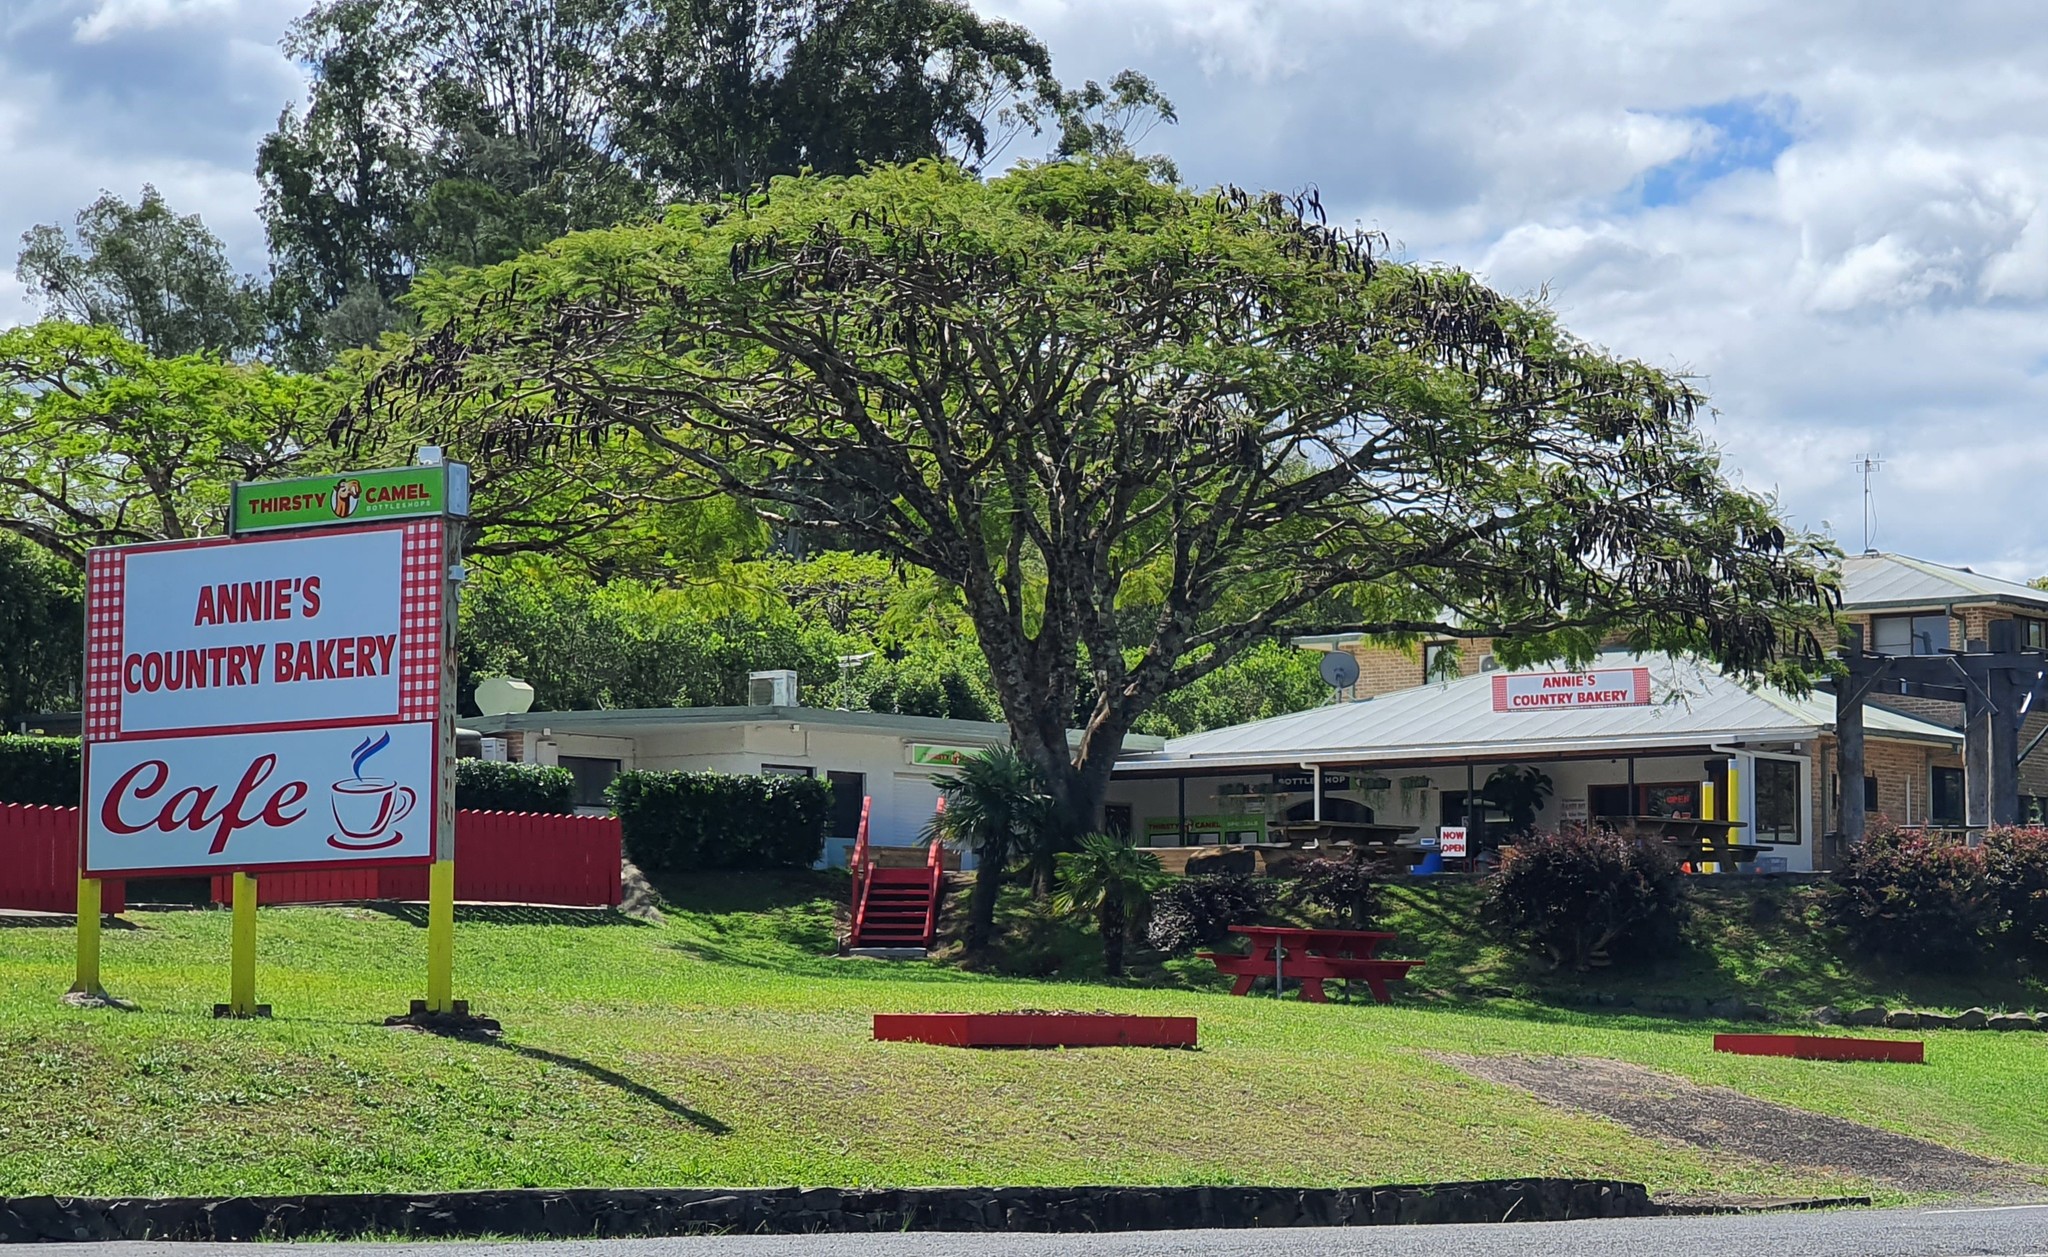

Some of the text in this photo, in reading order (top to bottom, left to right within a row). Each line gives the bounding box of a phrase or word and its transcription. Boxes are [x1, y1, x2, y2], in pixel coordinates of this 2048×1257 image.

[249, 483, 431, 514] THIRSTY CAMEL
[366, 500, 431, 512] BOTTLESHOPS
[194, 576, 321, 627] ANNIE'S
[123, 634, 398, 694] COUNTRY BAKERY
[1542, 675, 1596, 689] ANNIE'S
[1513, 690, 1628, 706] COUNTRY BAKERY
[101, 753, 308, 855] Cafe
[1442, 831, 1464, 840] NOW
[1442, 843, 1465, 852] OPEN
